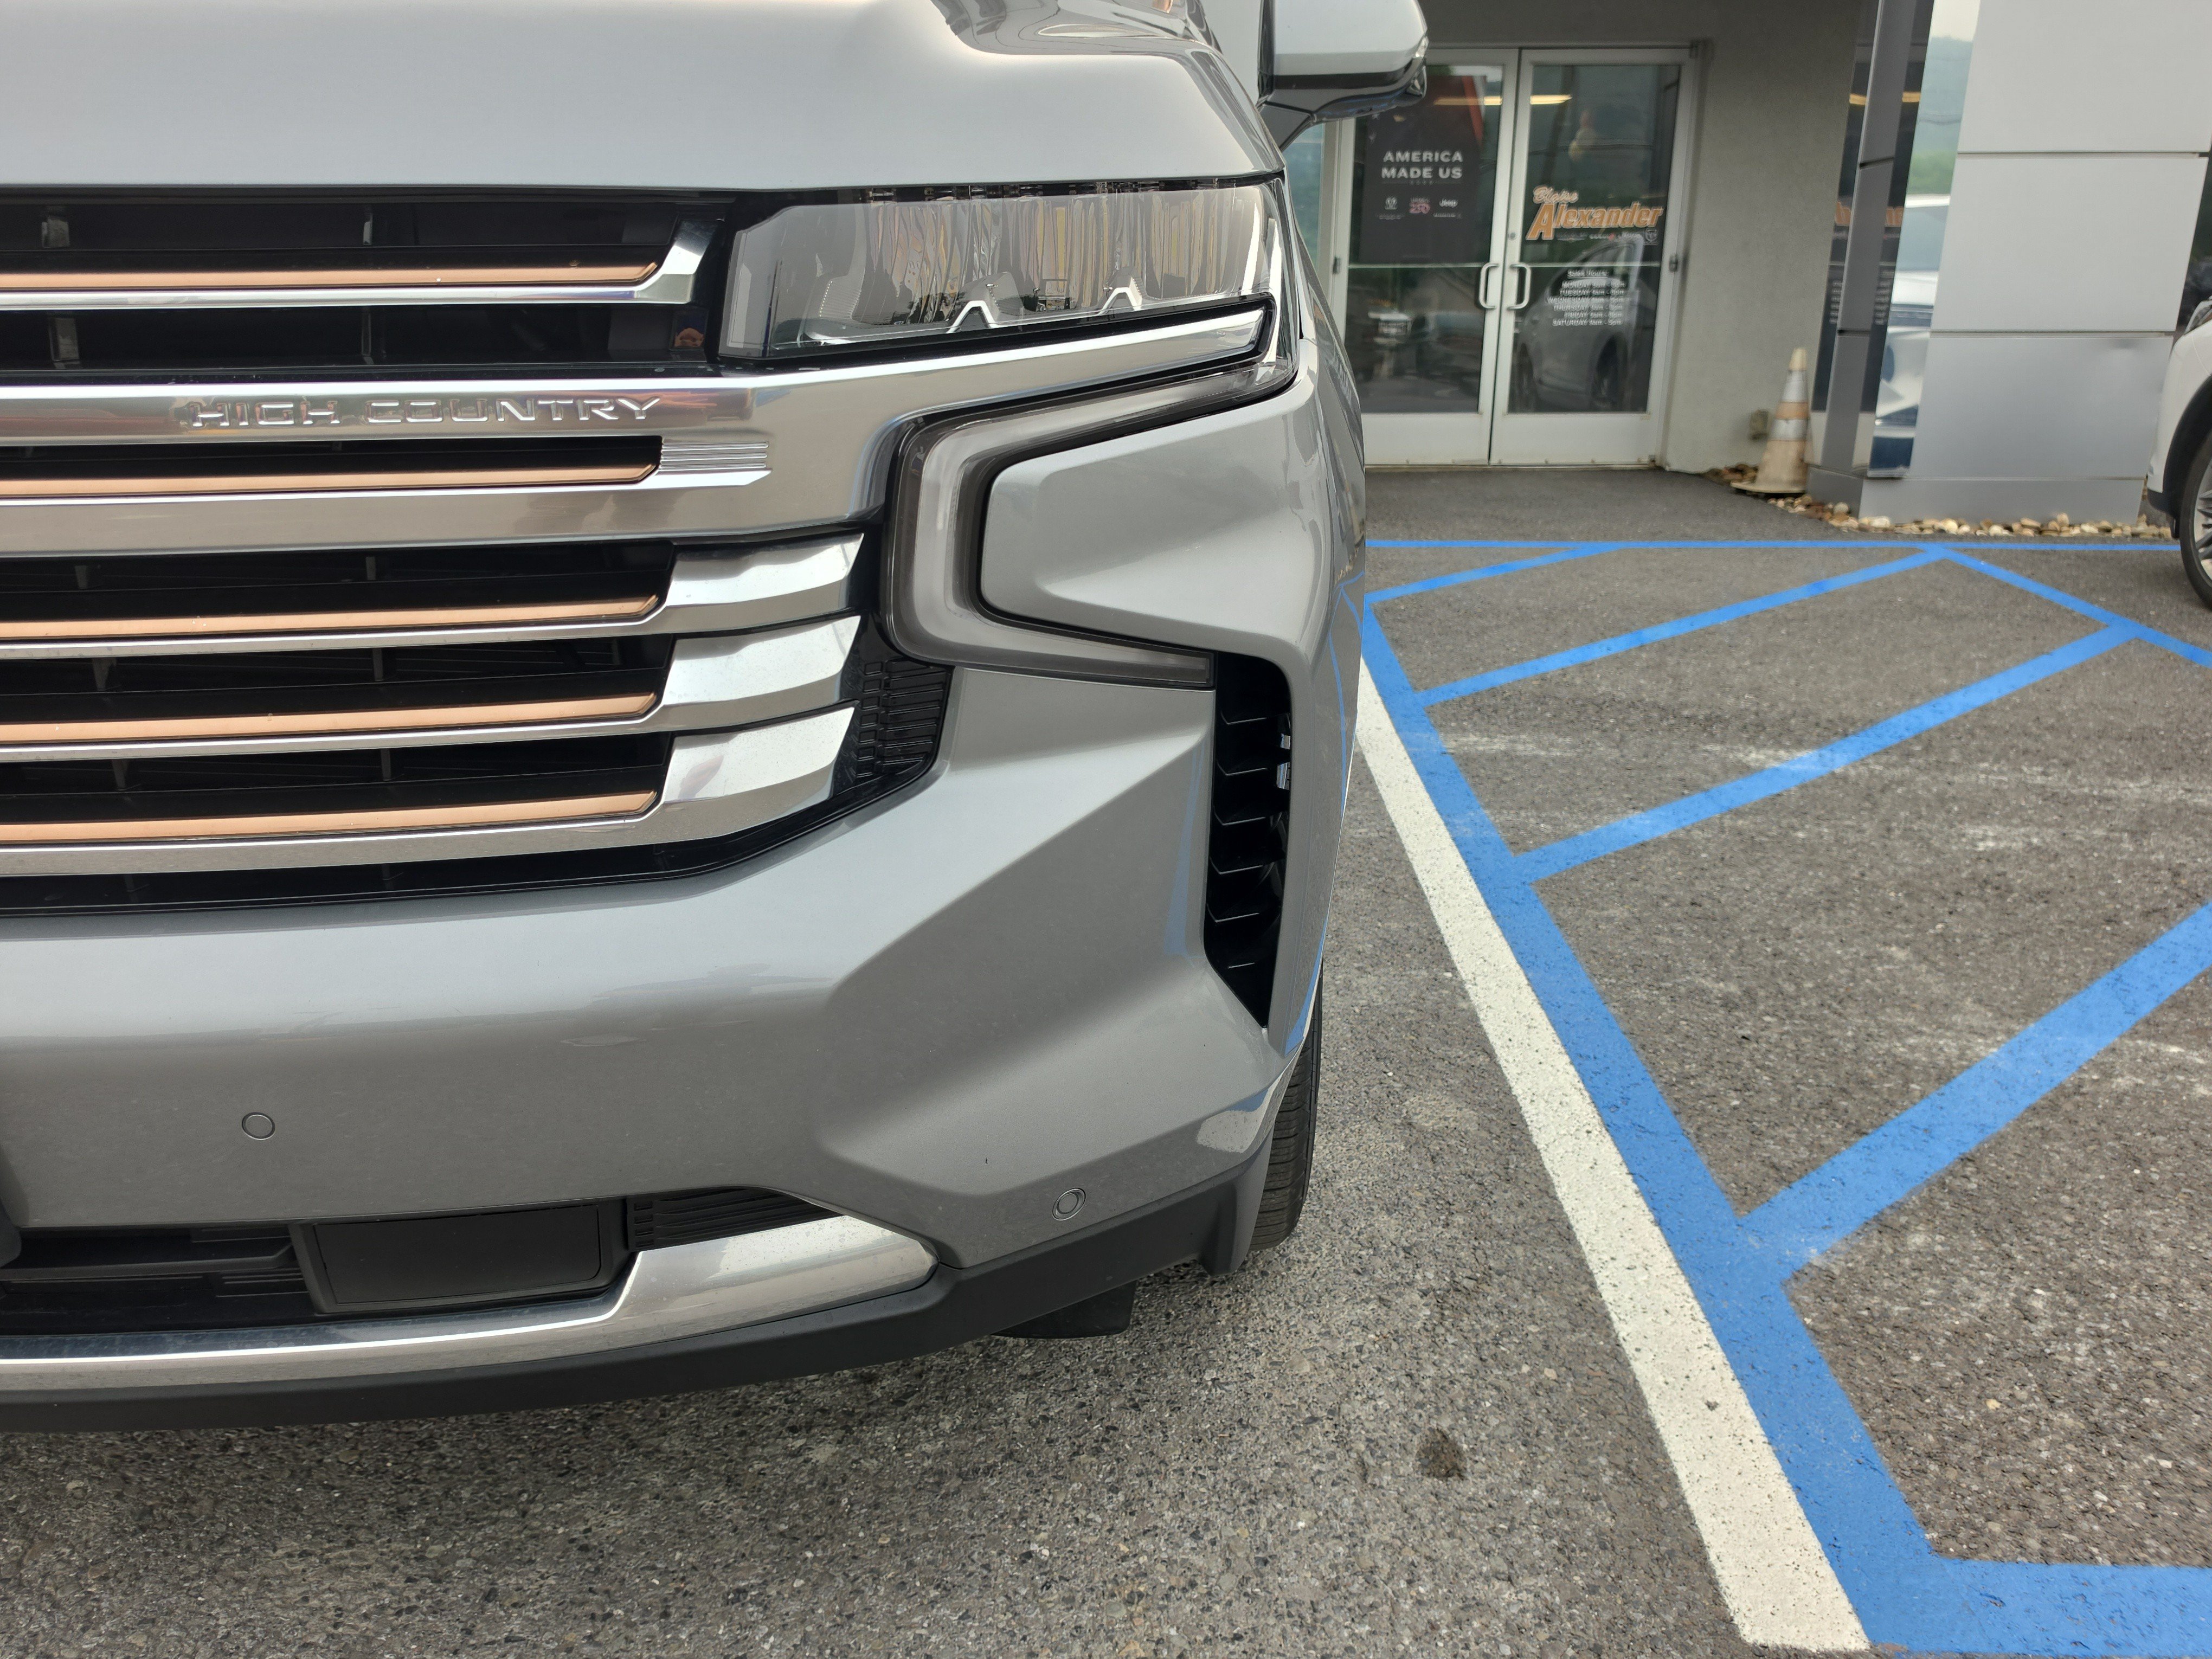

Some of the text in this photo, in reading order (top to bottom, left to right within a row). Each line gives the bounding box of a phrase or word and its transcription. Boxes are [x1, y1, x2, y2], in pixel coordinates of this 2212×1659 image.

[1382, 150, 1463, 162] AMERICA
[1381, 166, 1463, 179] MADE US
[1525, 201, 1664, 241] Alexander
[188, 397, 660, 427] HIGH COUNTRY
